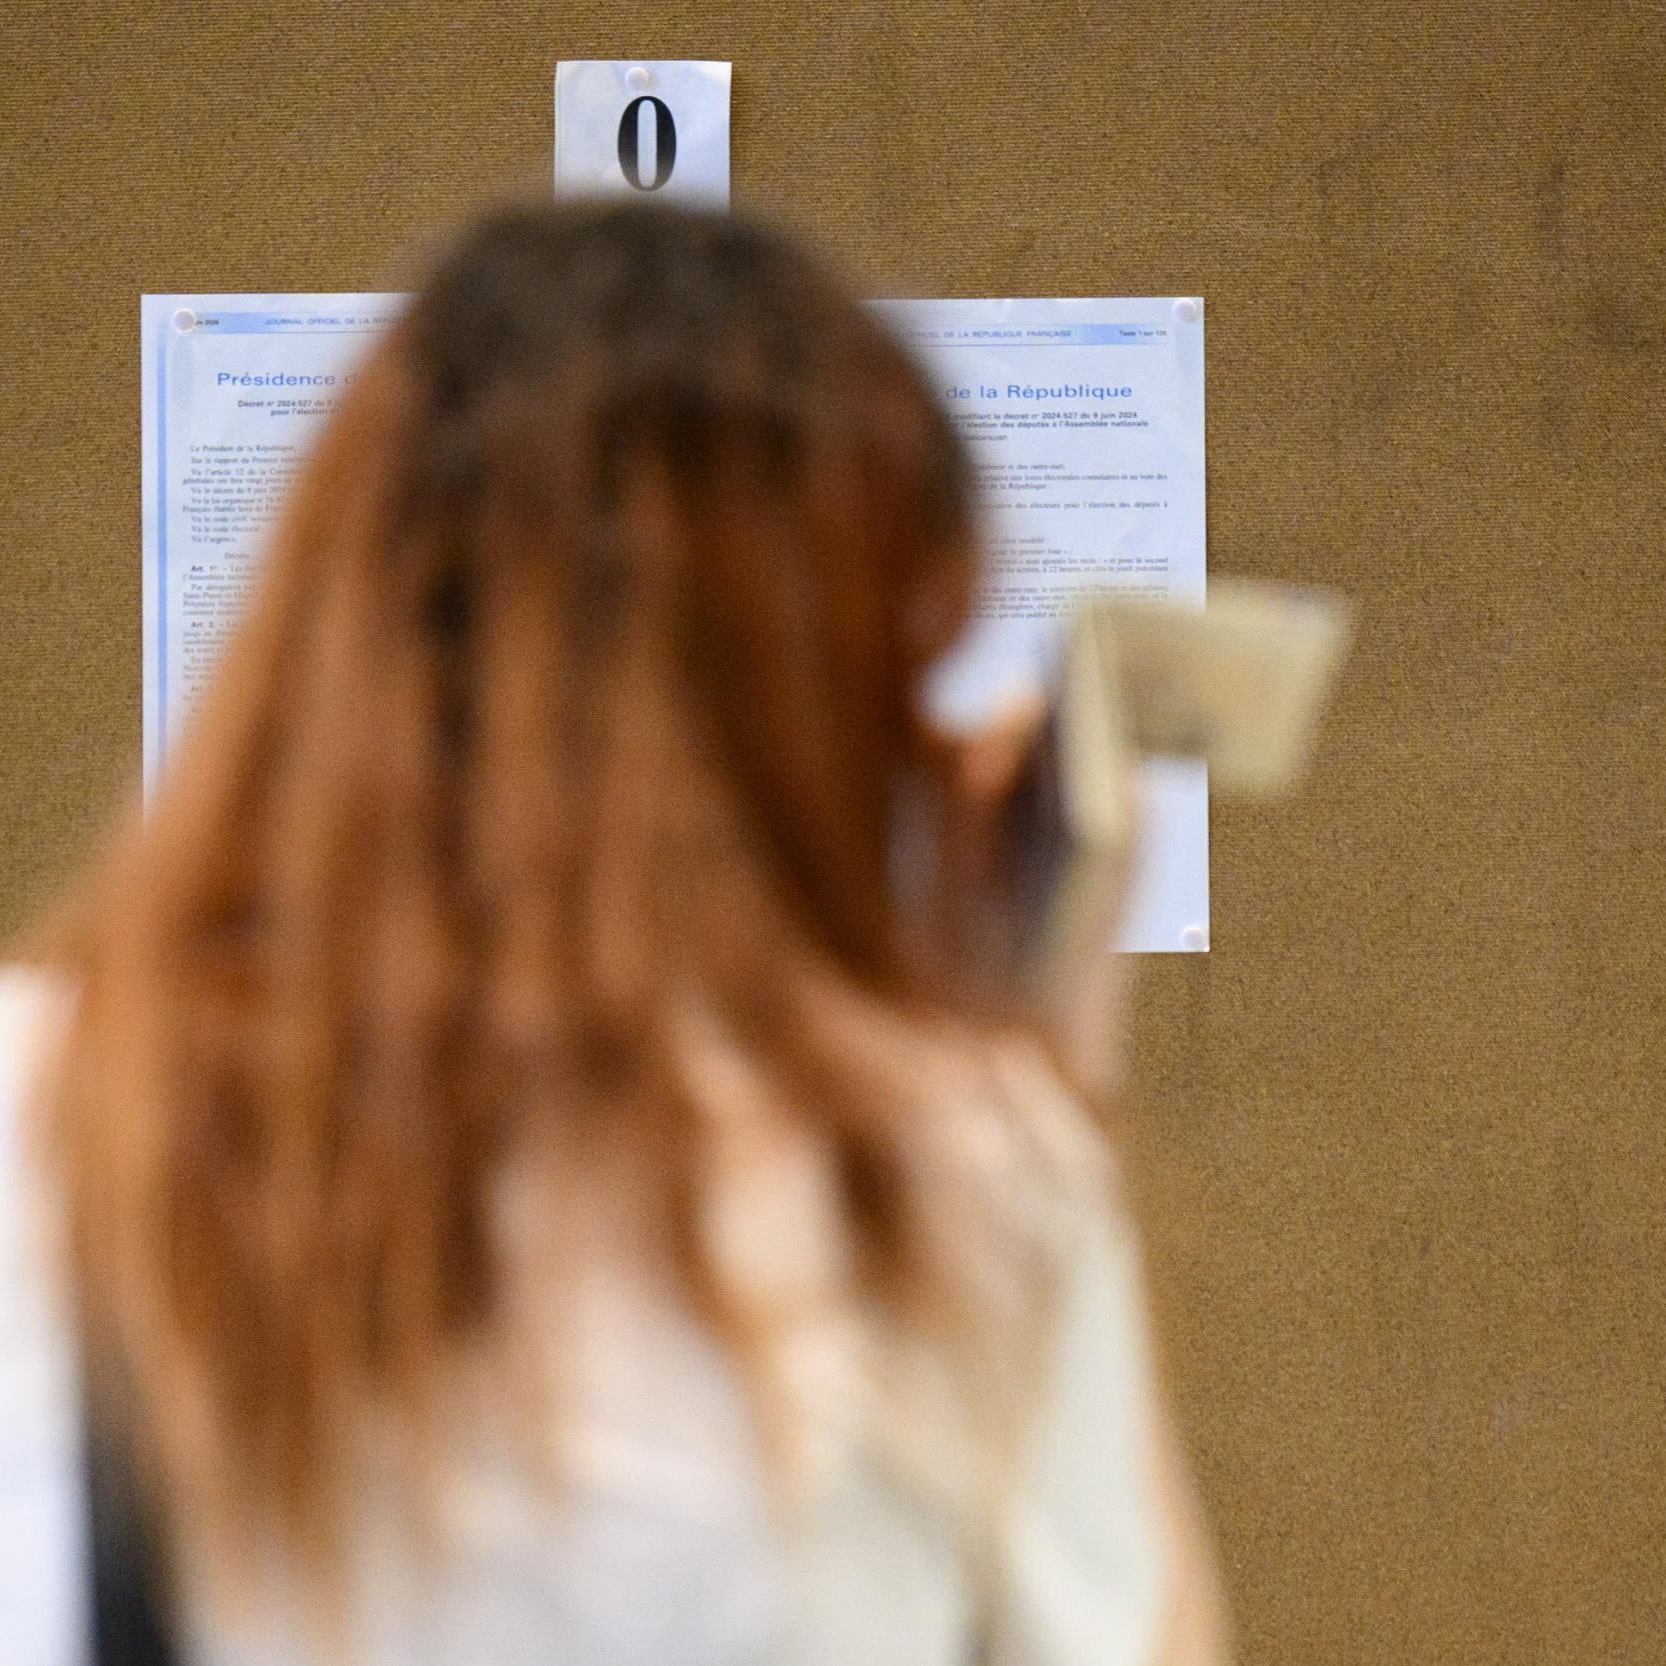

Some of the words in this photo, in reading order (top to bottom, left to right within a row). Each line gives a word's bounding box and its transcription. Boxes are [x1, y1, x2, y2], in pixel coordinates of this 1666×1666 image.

[264, 318, 303, 326] JOURNAL
[216, 371, 336, 387] Présidence
[945, 384, 971, 400] de
[980, 384, 998, 399] la
[1007, 383, 1133, 402] République
